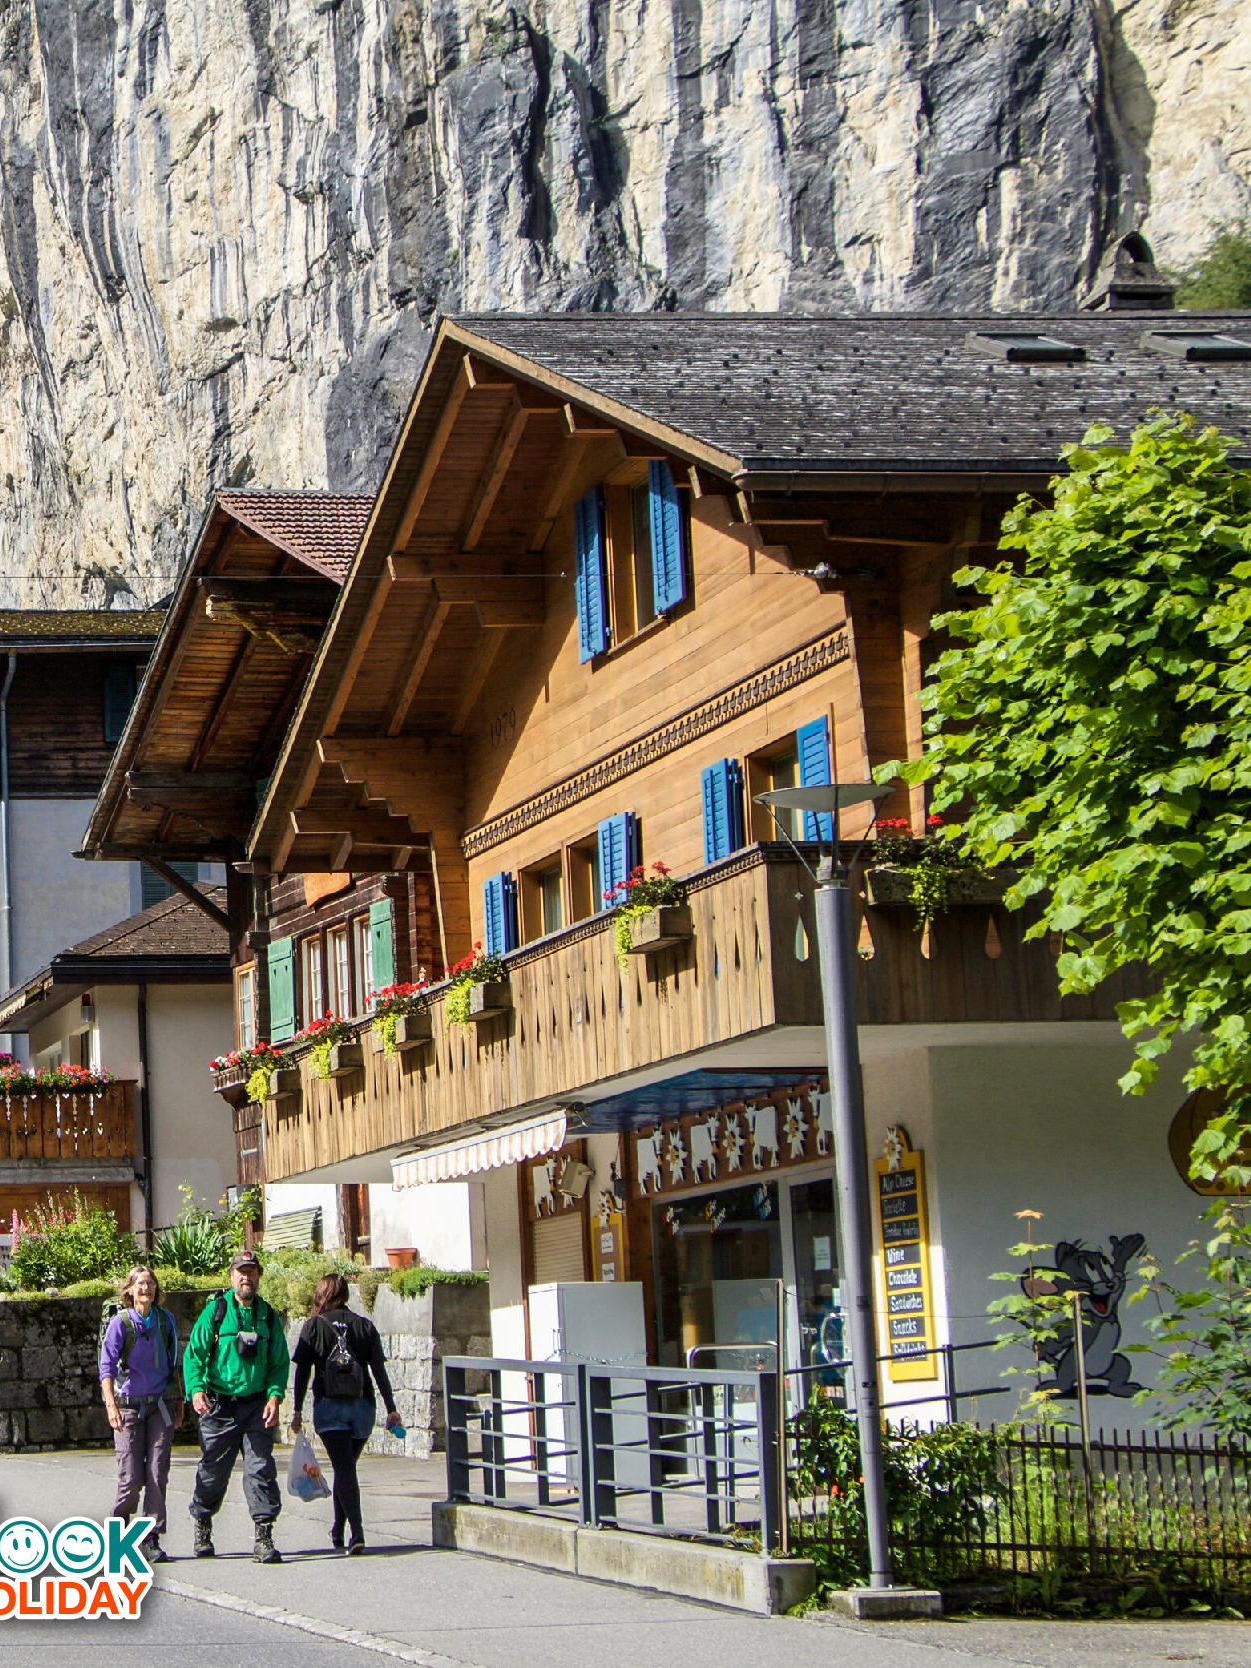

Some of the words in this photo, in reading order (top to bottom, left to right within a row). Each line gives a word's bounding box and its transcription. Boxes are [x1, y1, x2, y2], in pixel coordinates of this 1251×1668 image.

[887, 1248, 905, 1264] Wine
[888, 1269, 918, 1286] Chocolate
[891, 1294, 923, 1312] Sandwiches
[893, 1319, 917, 1335] Snacks
